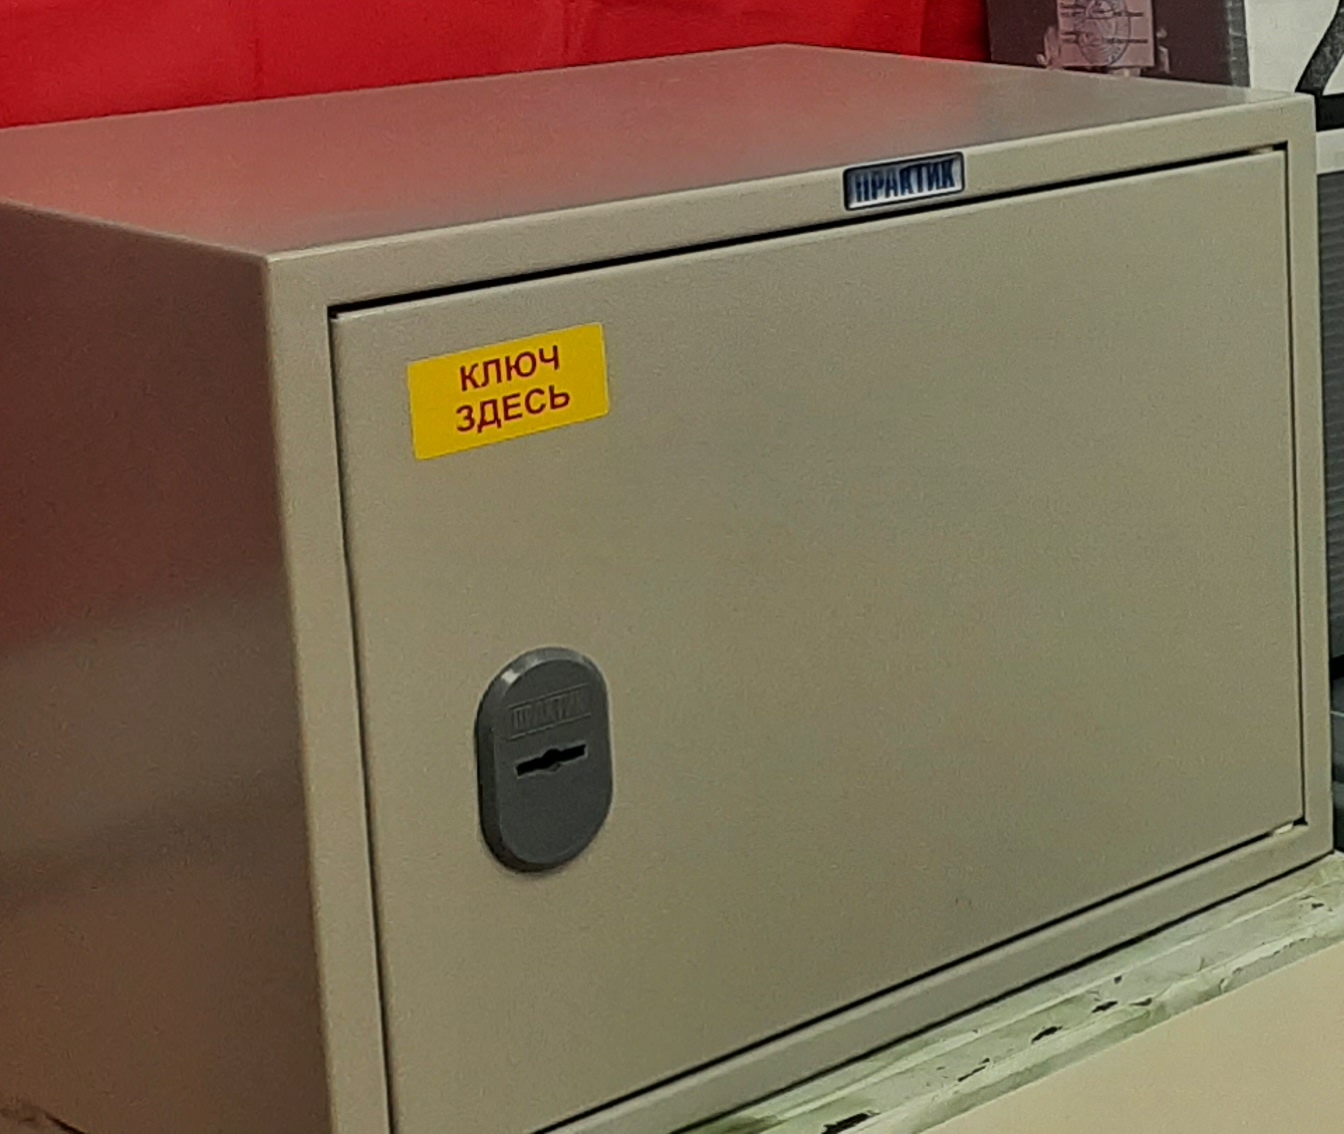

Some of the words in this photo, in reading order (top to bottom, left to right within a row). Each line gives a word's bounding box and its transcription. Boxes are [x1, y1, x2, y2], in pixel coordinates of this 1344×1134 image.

[855, 158, 957, 204] ПРАКТИК
[460, 345, 560, 392] КЛЮЧ
[456, 385, 571, 434] ЗДЕСЬ
